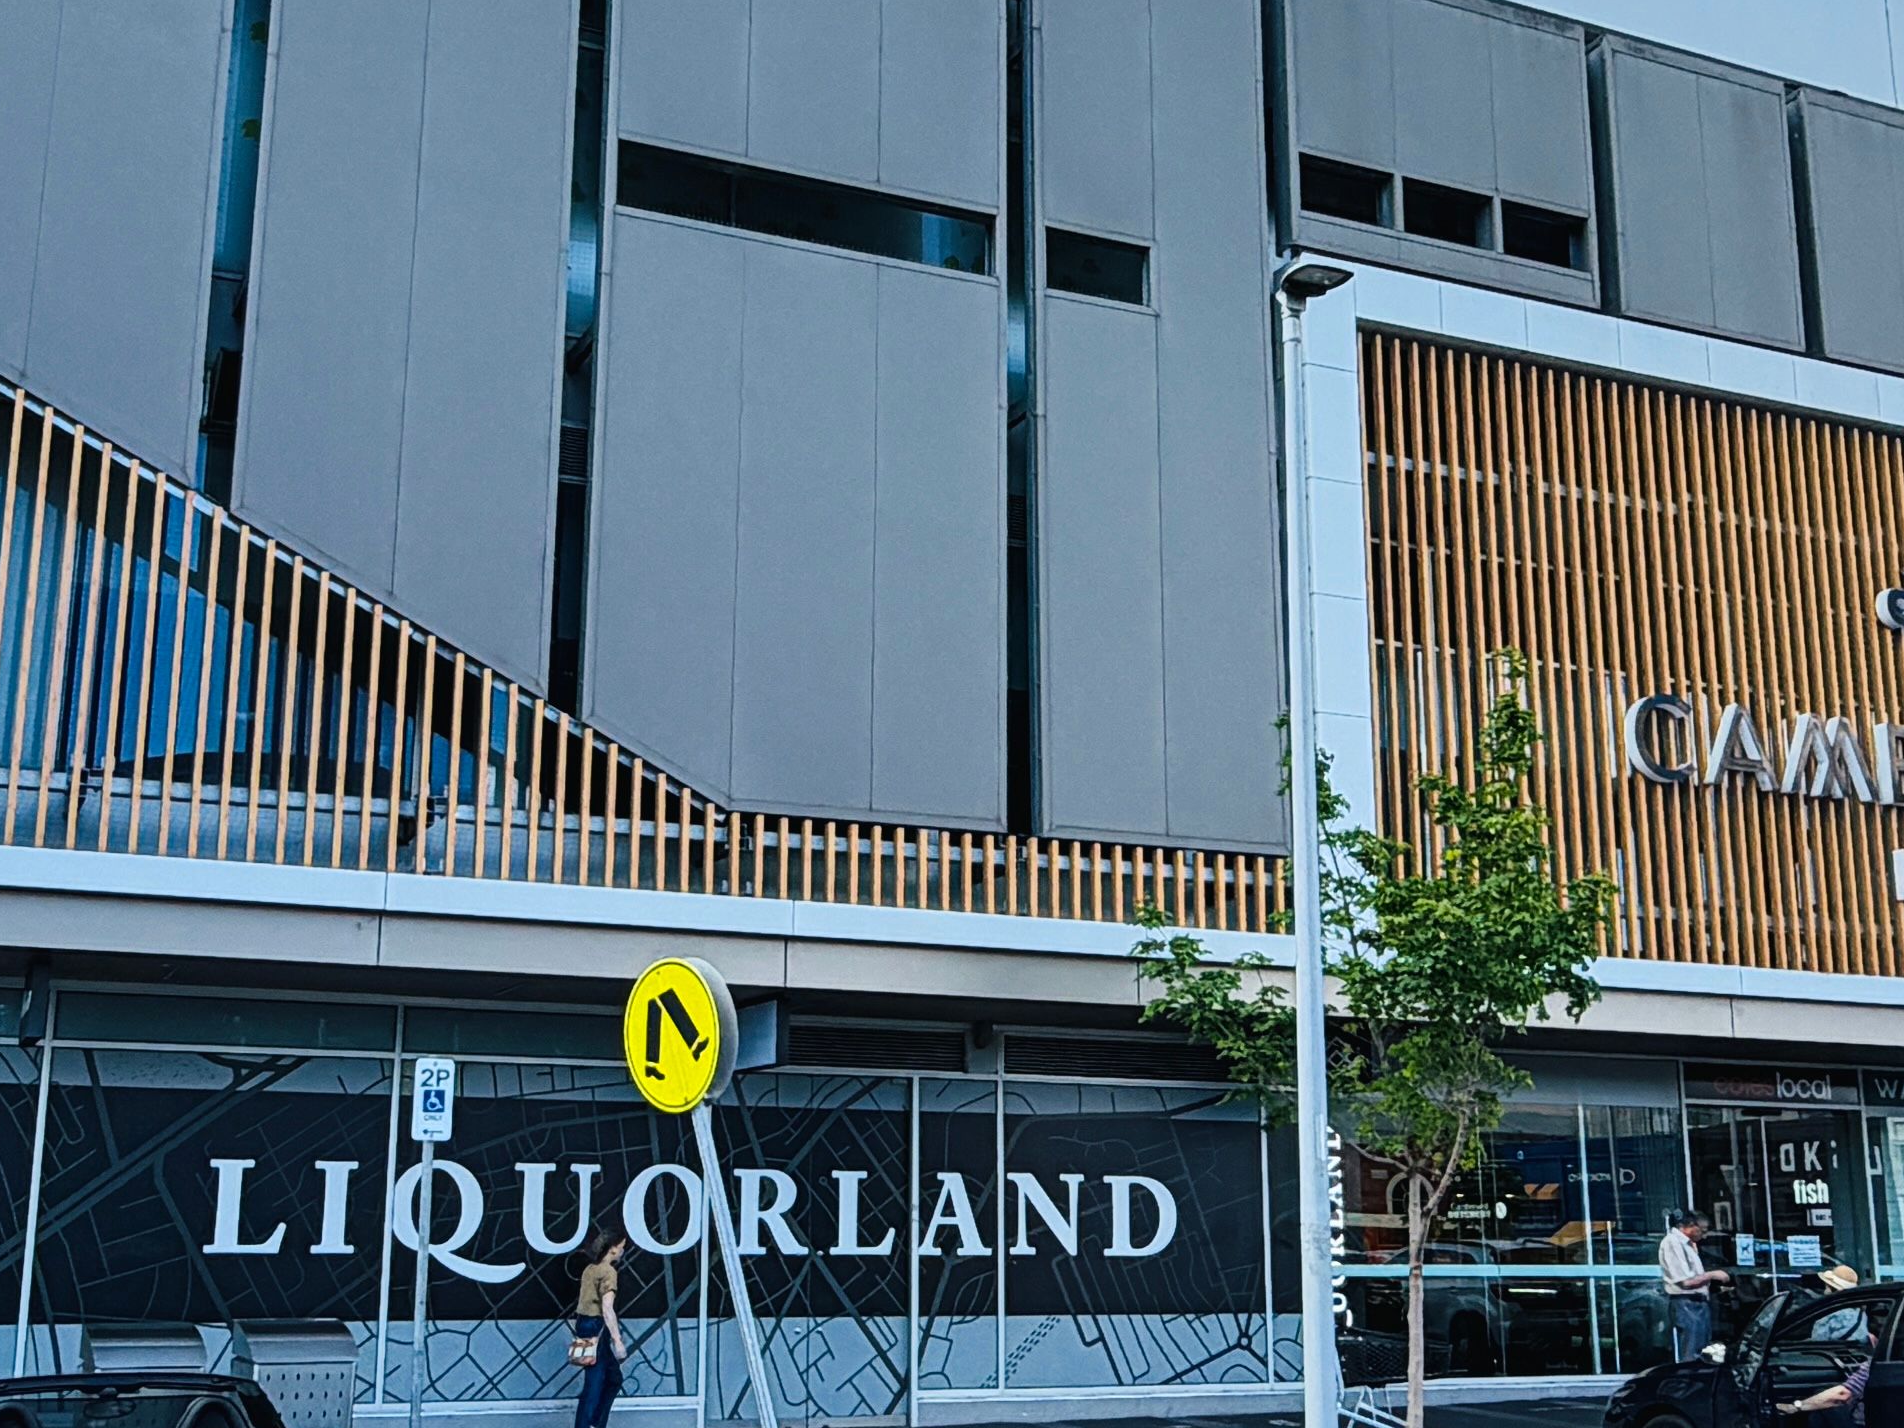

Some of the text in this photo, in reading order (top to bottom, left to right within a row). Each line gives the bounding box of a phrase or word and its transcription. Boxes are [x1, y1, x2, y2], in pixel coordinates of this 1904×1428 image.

[420, 1068, 450, 1087] 2P
[1793, 1179, 1830, 1204] fish
[202, 1158, 1178, 1284] LIQUORLAND
